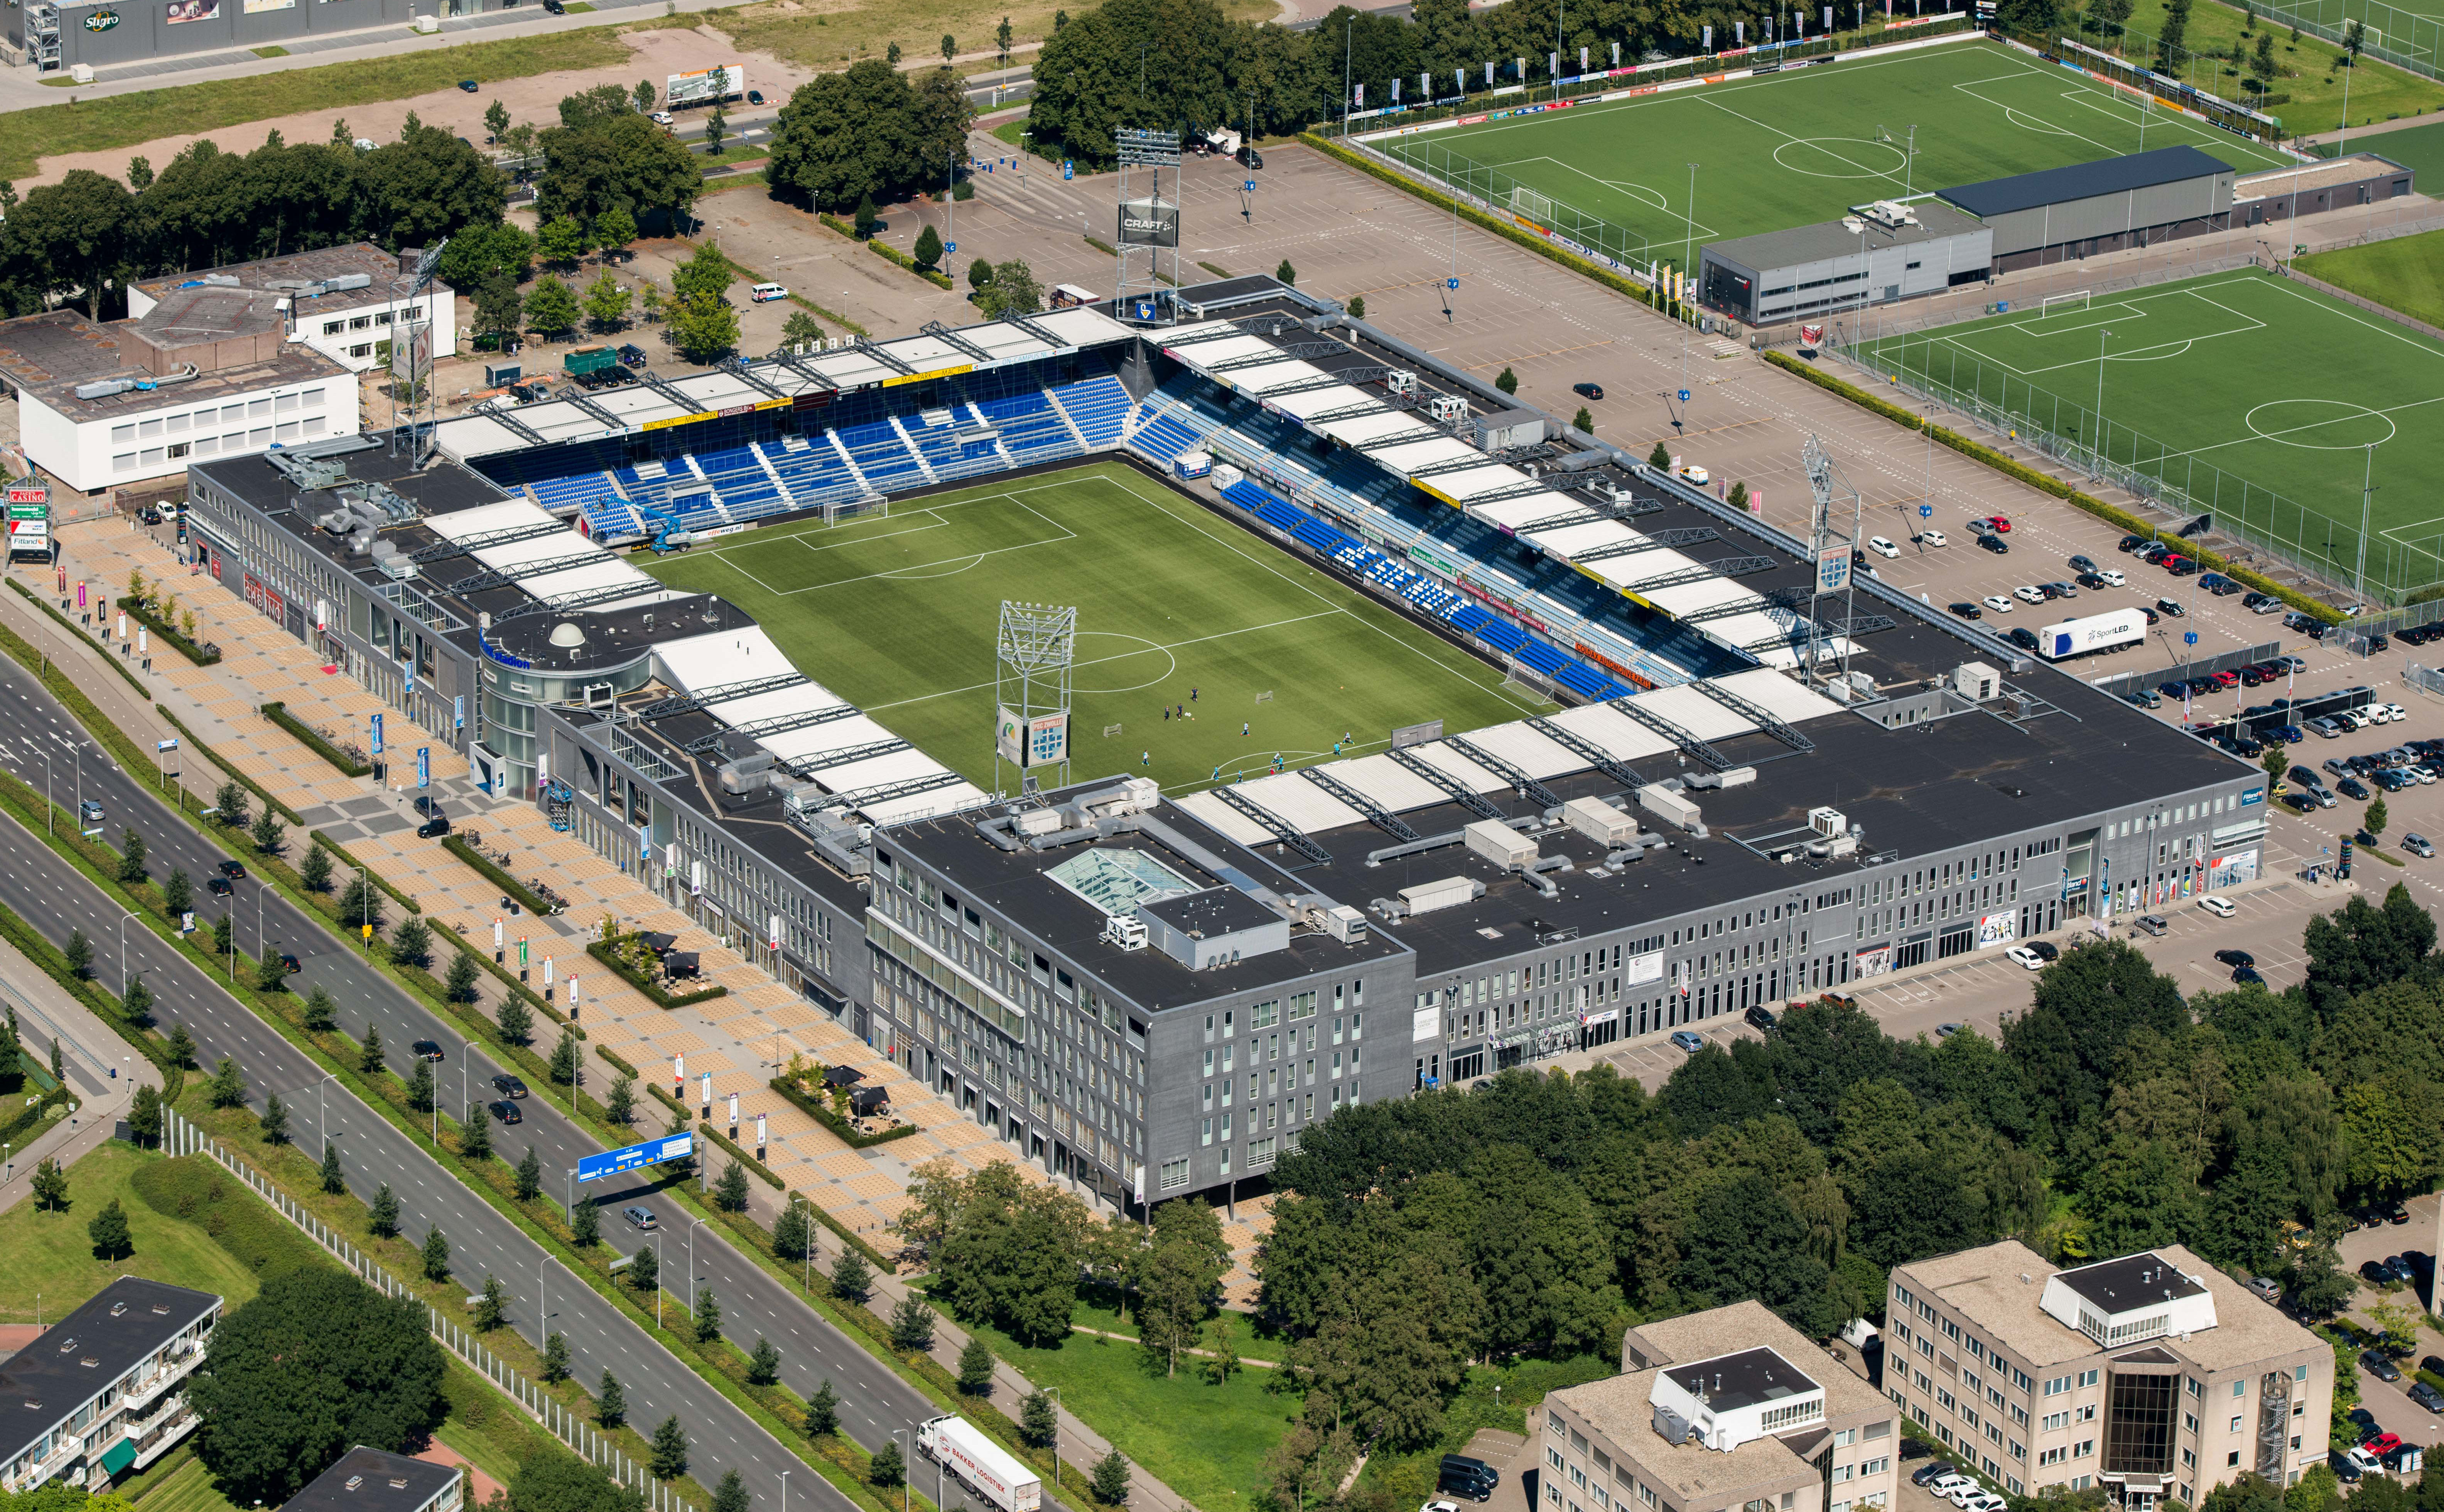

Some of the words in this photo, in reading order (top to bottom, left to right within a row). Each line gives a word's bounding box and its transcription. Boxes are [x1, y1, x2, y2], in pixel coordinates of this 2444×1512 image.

[86, 15, 119, 28] Sligro
[2094, 72, 2104, 81] BRUIN
[2105, 77, 2115, 85] BRUIN
[1124, 218, 1163, 230] CRAFT
[756, 398, 792, 409] paintball-nijbroek.nl
[1471, 509, 1487, 521] VELDHUIS
[1487, 517, 1497, 527] MEDIA
[707, 525, 741, 537] effeweg.nl
[1367, 530, 1381, 541] Hakron
[1389, 540, 1400, 551] LUMEN
[1431, 556, 1439, 566] PEC
[1823, 553, 1831, 561] PEC
[1831, 549, 1847, 559] ZWOLLE
[2097, 625, 2128, 639] SportLED
[1560, 634, 1574, 646] GROUP
[1731, 646, 1759, 662] www.ter-weele.nl
[495, 651, 530, 670] stadion
[1576, 645, 1599, 662] COLDAX
[1600, 656, 1633, 680] AUTOMOTIVE
[1634, 674, 1650, 690] PARTS
[1044, 718, 1062, 728] ZWOLLE
[2243, 792, 2258, 801] Fitland
[2068, 877, 2081, 887] tland
[1897, 995, 1909, 1003] NP
[952, 1448, 975, 1470] BAKKER
[977, 1466, 1005, 1494] LOGISTIEK
